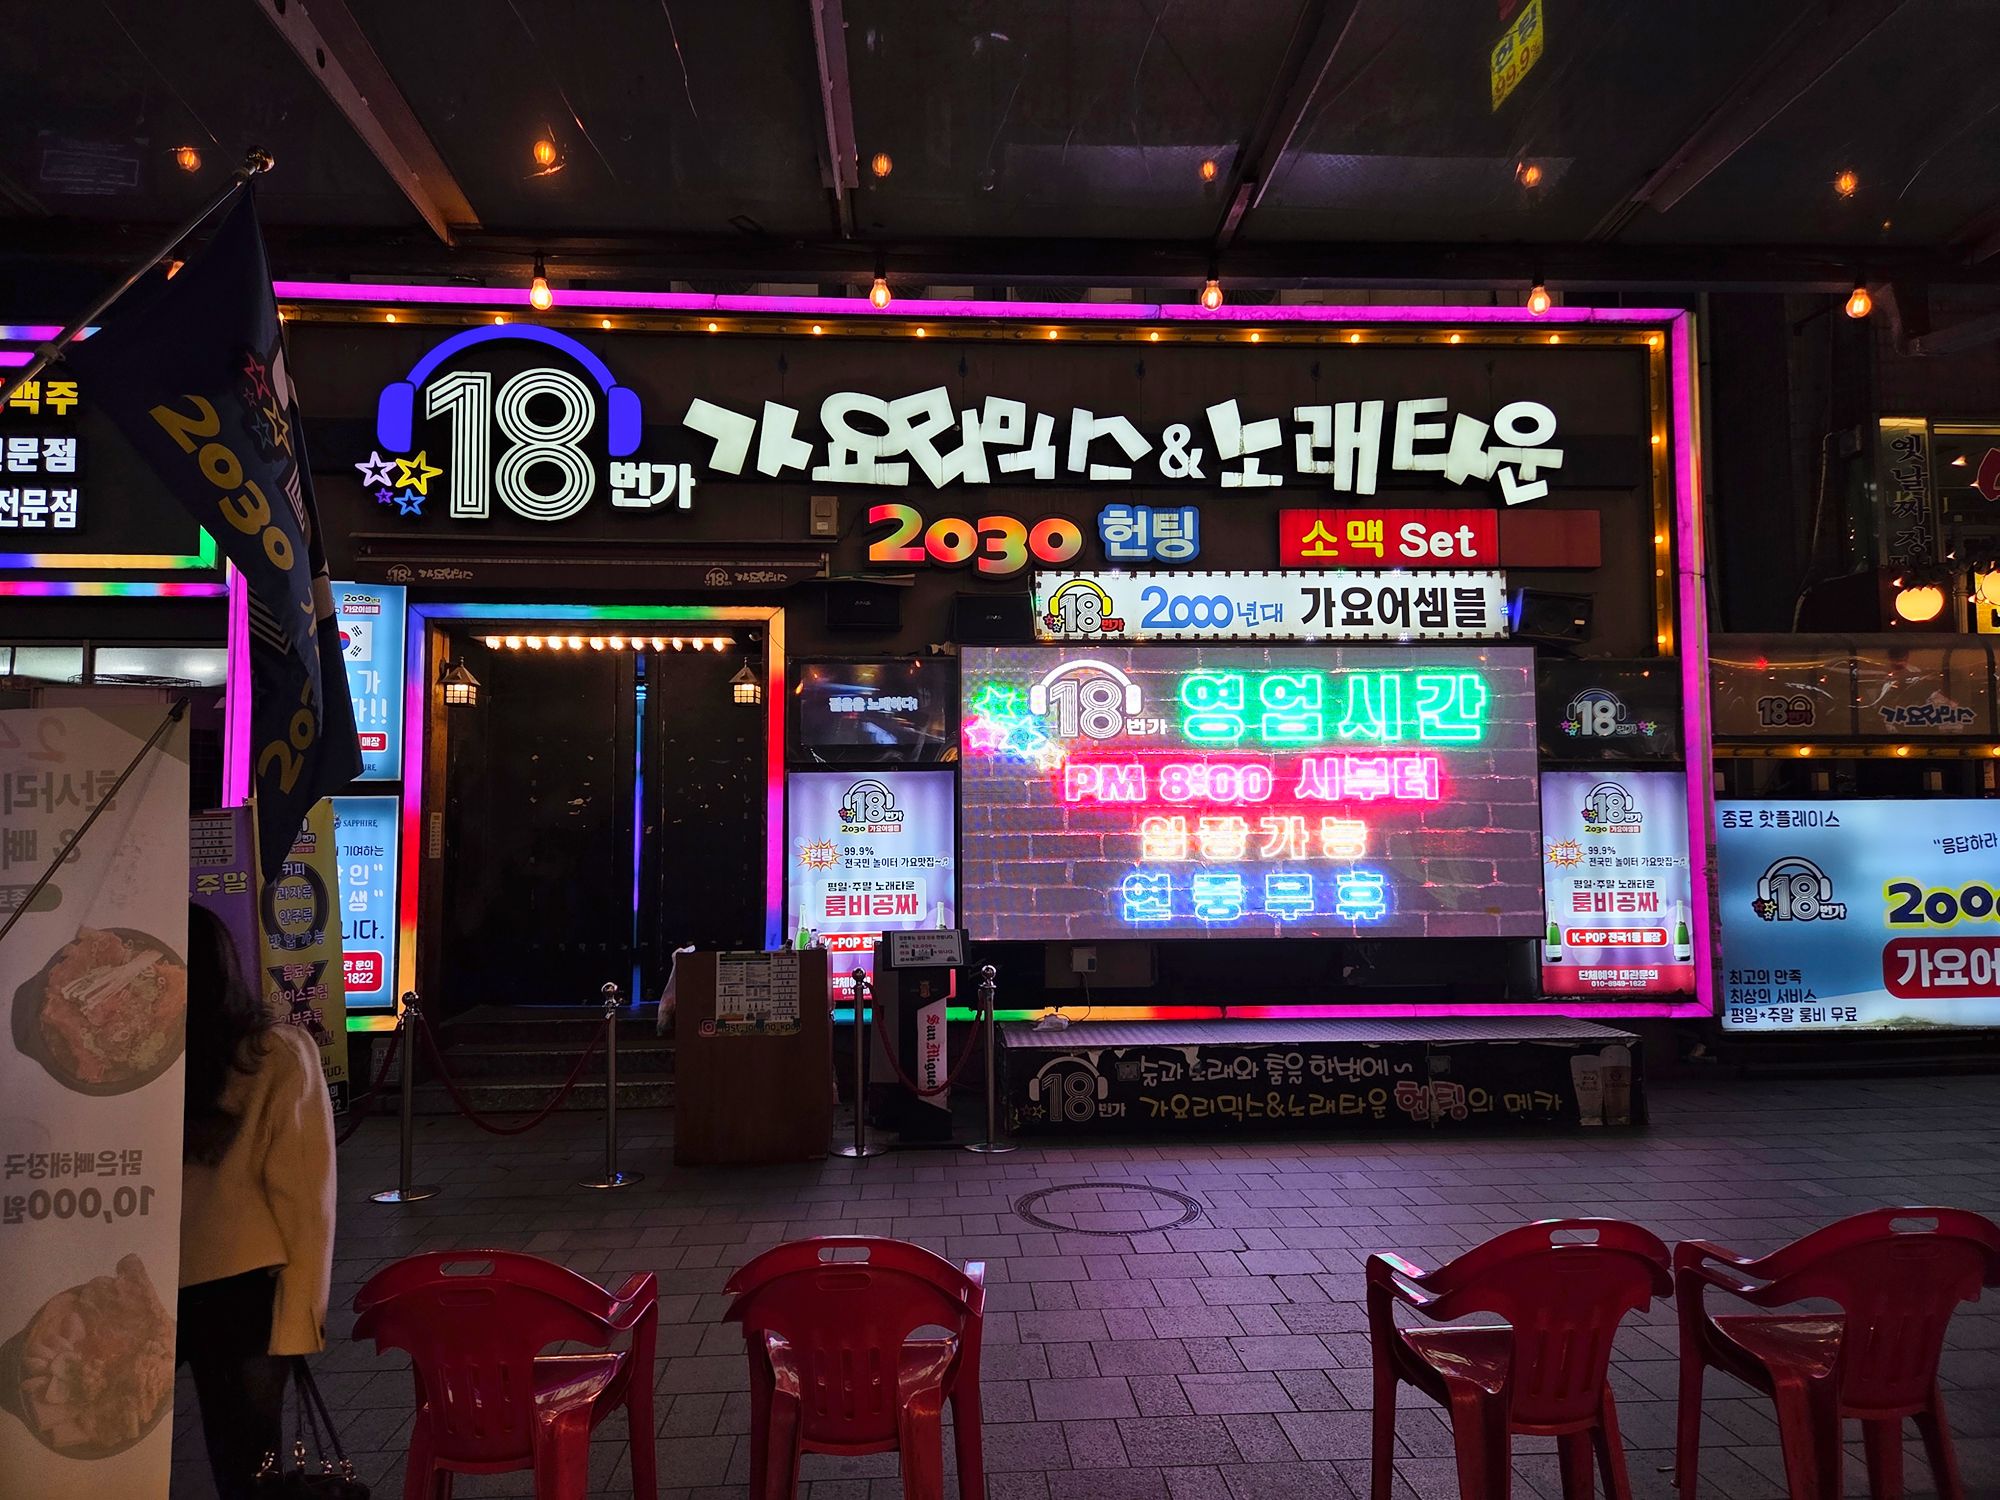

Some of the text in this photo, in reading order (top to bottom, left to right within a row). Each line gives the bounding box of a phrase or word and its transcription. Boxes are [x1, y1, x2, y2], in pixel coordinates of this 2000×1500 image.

[148, 394, 294, 571] 2030
[868, 504, 1195, 575] 2030 헌팅
[1399, 523, 1478, 558] Set
[1140, 585, 1284, 630] 2000년대
[1300, 586, 1487, 628] 가요어셈블
[1180, 673, 1488, 742] 영업시간
[1064, 757, 1440, 803] PM 8:00 시부터
[1721, 809, 1841, 829] 종로 핫플레이스
[344, 844, 384, 858] 기여하는
[844, 846, 875, 856] 99.9%
[1588, 846, 1617, 856] 99.9%
[1588, 857, 1613, 868] 전국민
[844, 858, 871, 869] 전국민
[825, 893, 920, 918] 룸비공짜
[1121, 871, 1387, 922] 연중무휴
[1572, 891, 1660, 914] 룸비공짜
[1887, 881, 2000, 924] 200
[1572, 932, 1607, 943] K-POP
[1729, 968, 1802, 986] 최고의 만족
[1730, 987, 1818, 1005] 최상의 서비스
[1799, 1006, 1827, 1024] 룸비
[1830, 1006, 1858, 1023] 무료
[923, 1013, 942, 1091] San Miguel
